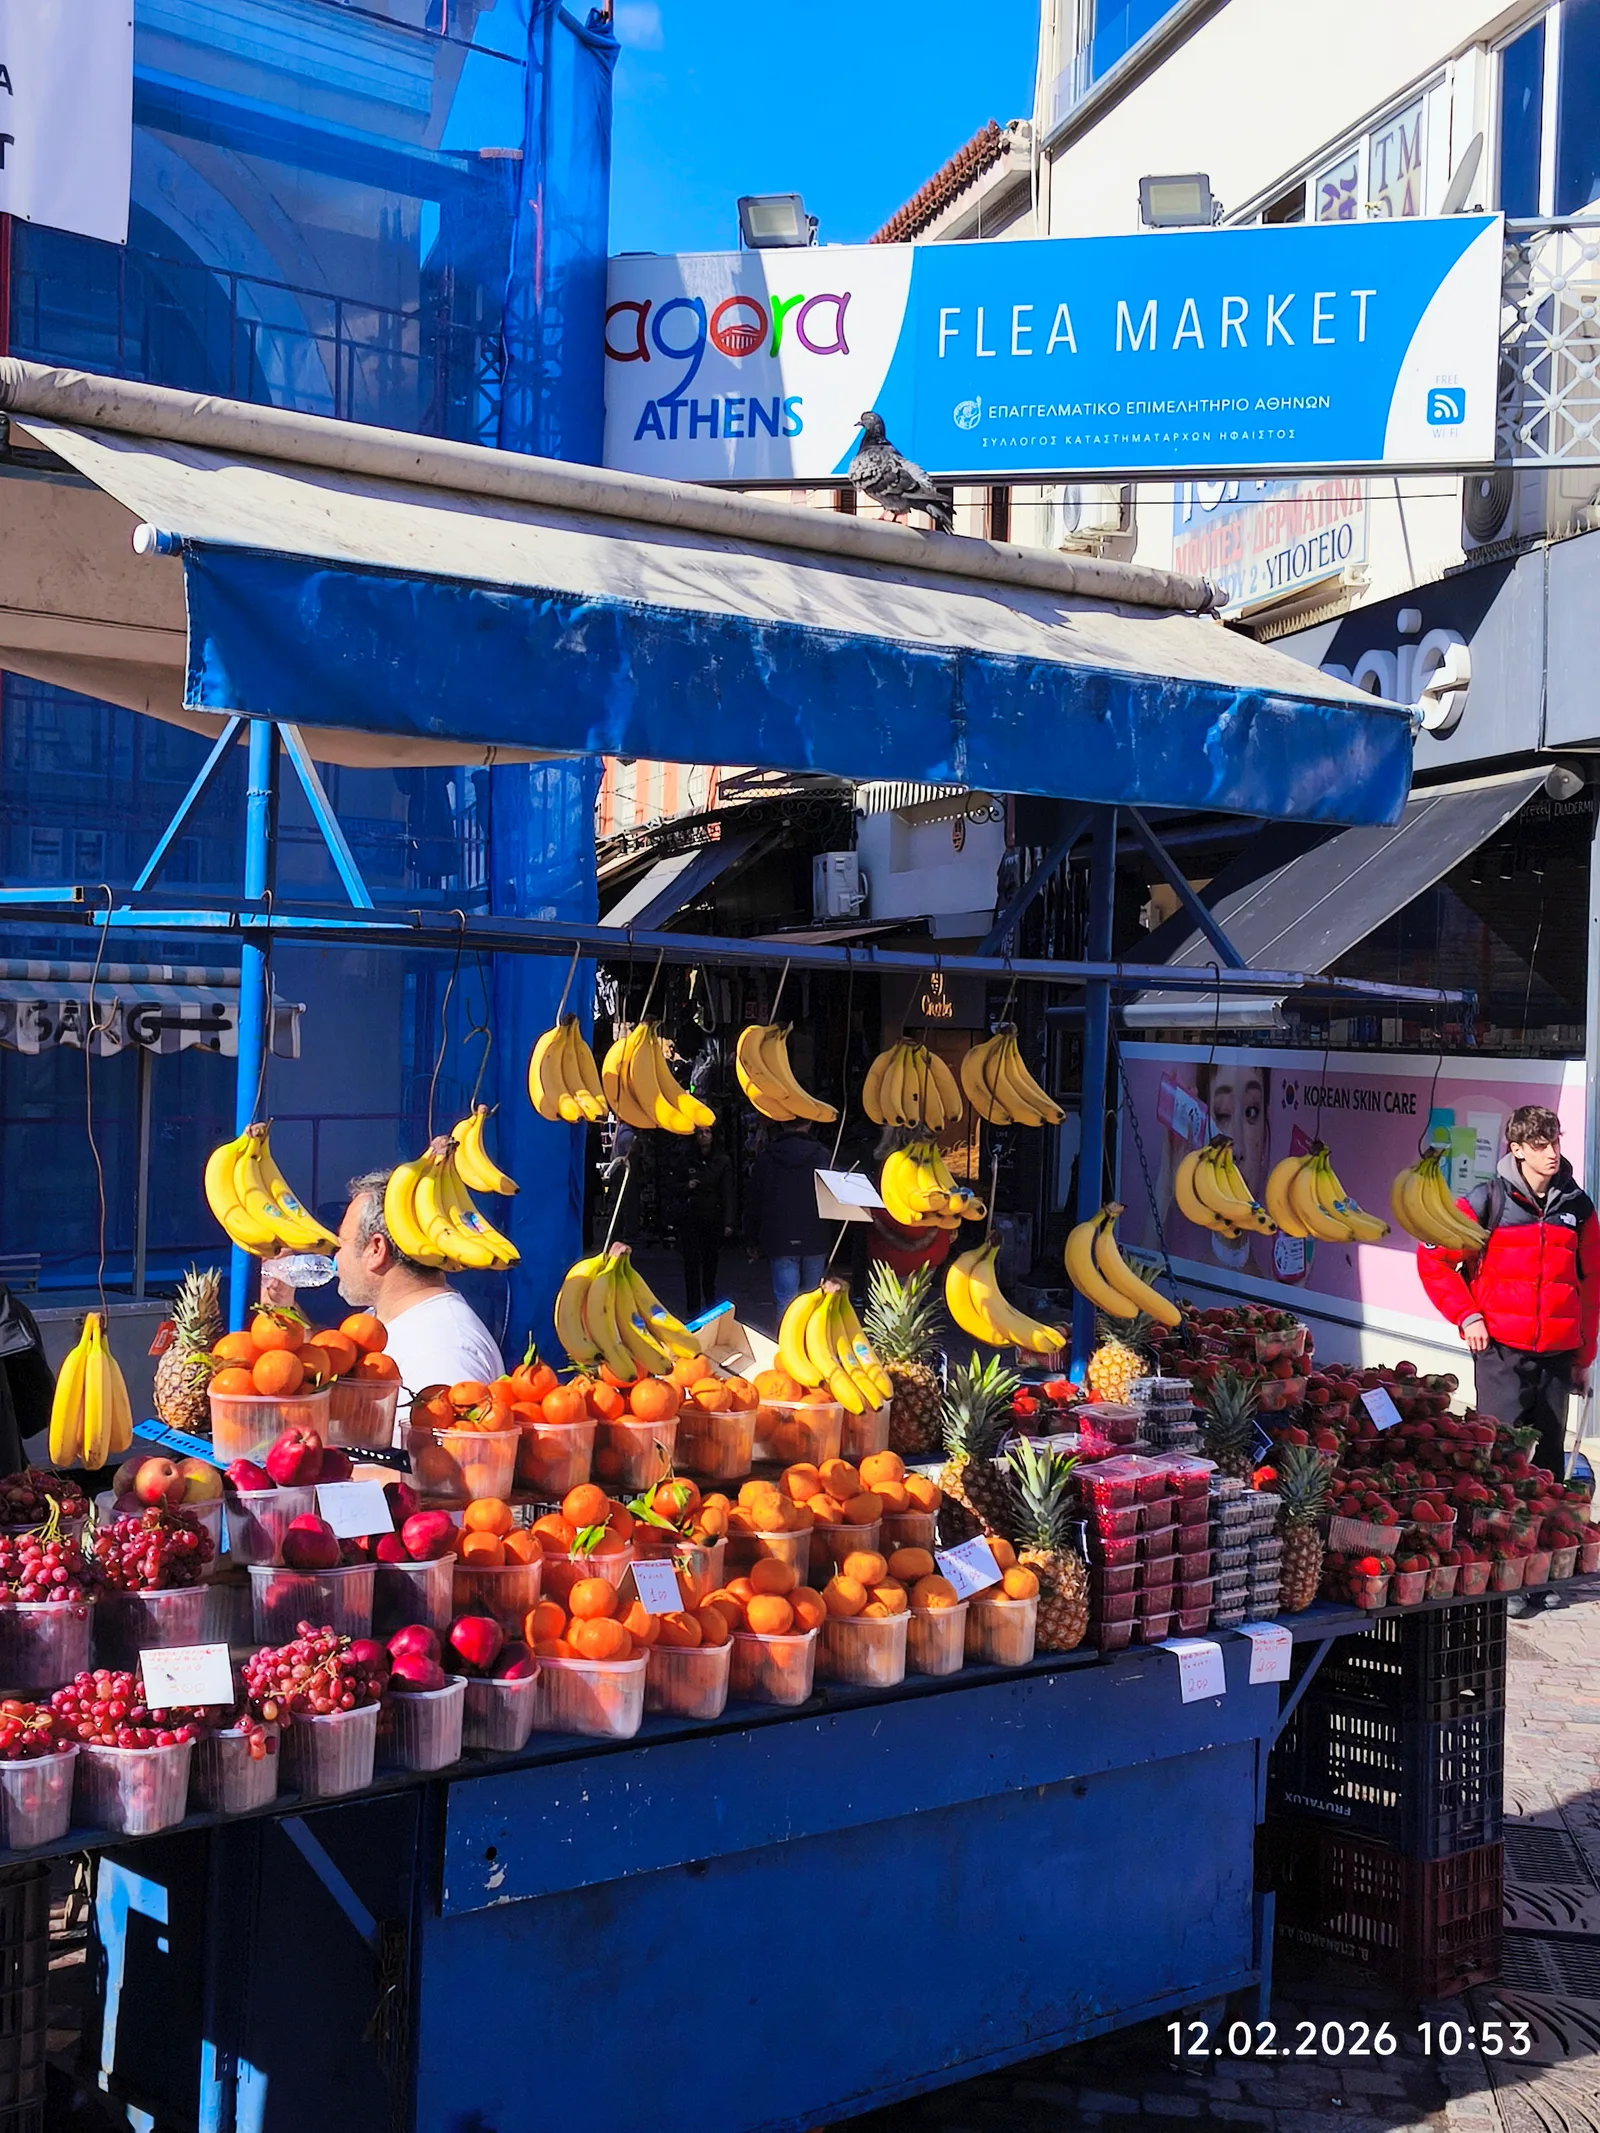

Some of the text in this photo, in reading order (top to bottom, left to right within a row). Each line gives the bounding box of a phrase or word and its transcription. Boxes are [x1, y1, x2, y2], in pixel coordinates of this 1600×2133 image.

[938, 289, 1377, 358] FLEA MARKET
[604, 291, 851, 407] agora
[1435, 374, 1459, 385] FREE
[633, 396, 803, 441] ATHENS
[988, 402, 1121, 419] ΕΠΑΓΓΕΛΜΑΤΙΚΟ
[1126, 398, 1249, 415] ΕΠΙΜΕΛΗΤΗΡΙΟ
[1254, 395, 1331, 410] ΑΘΗΝΩΝ
[982, 428, 1296, 448] ΣΥΛΛΟΓΟΣ ΚΑΤΑΣΤΗΜΑΤΑΡΧΩΝ ΗΦΑΙΣΤΟΣ
[1265, 523, 1353, 590] ΥΠΟΓΕΙΟ
[1303, 1085, 1417, 1115] KOREAN SKIN CARE
[1284, 1791, 1352, 1816] FRUTALUX
